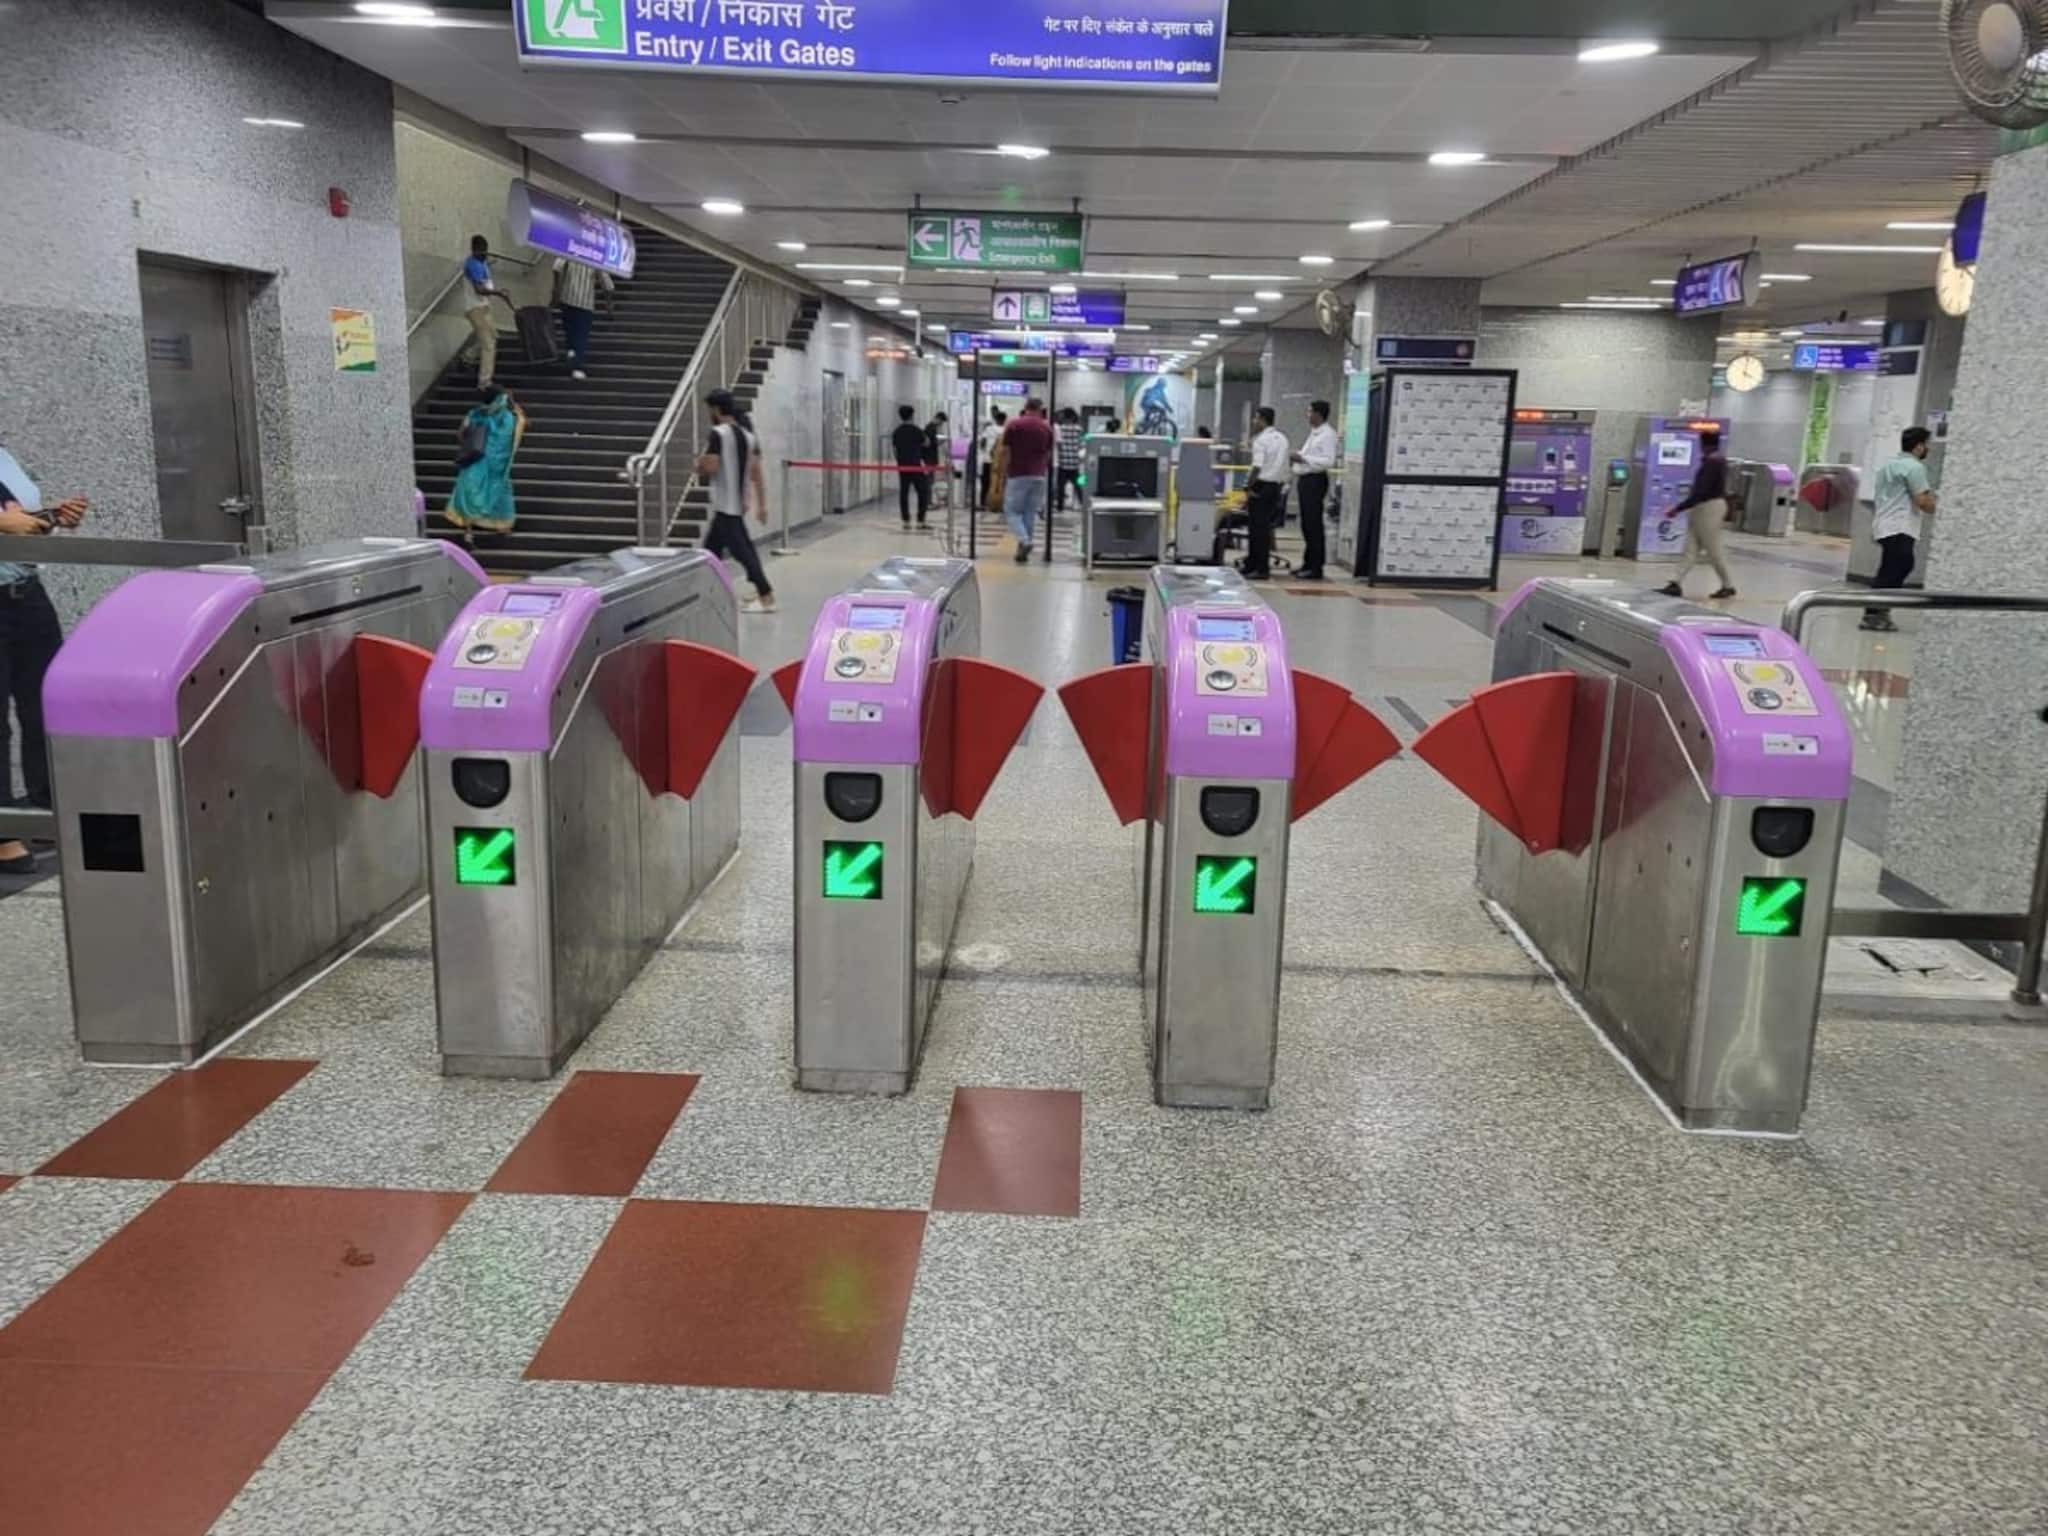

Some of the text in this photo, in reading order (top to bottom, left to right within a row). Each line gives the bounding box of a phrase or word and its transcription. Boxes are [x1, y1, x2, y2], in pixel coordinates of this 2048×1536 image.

[1044, 16, 1060, 33] गेट
[1063, 19, 1078, 32] पर
[1151, 20, 1190, 39] अनुसार
[635, 31, 704, 65] Entry
[723, 36, 773, 63] Exit
[780, 39, 856, 66] Gates
[990, 53, 1032, 67] Follow
[1033, 54, 1061, 71] light
[1135, 59, 1151, 71] on
[1154, 58, 1174, 72] the
[1176, 61, 1212, 74] gates
